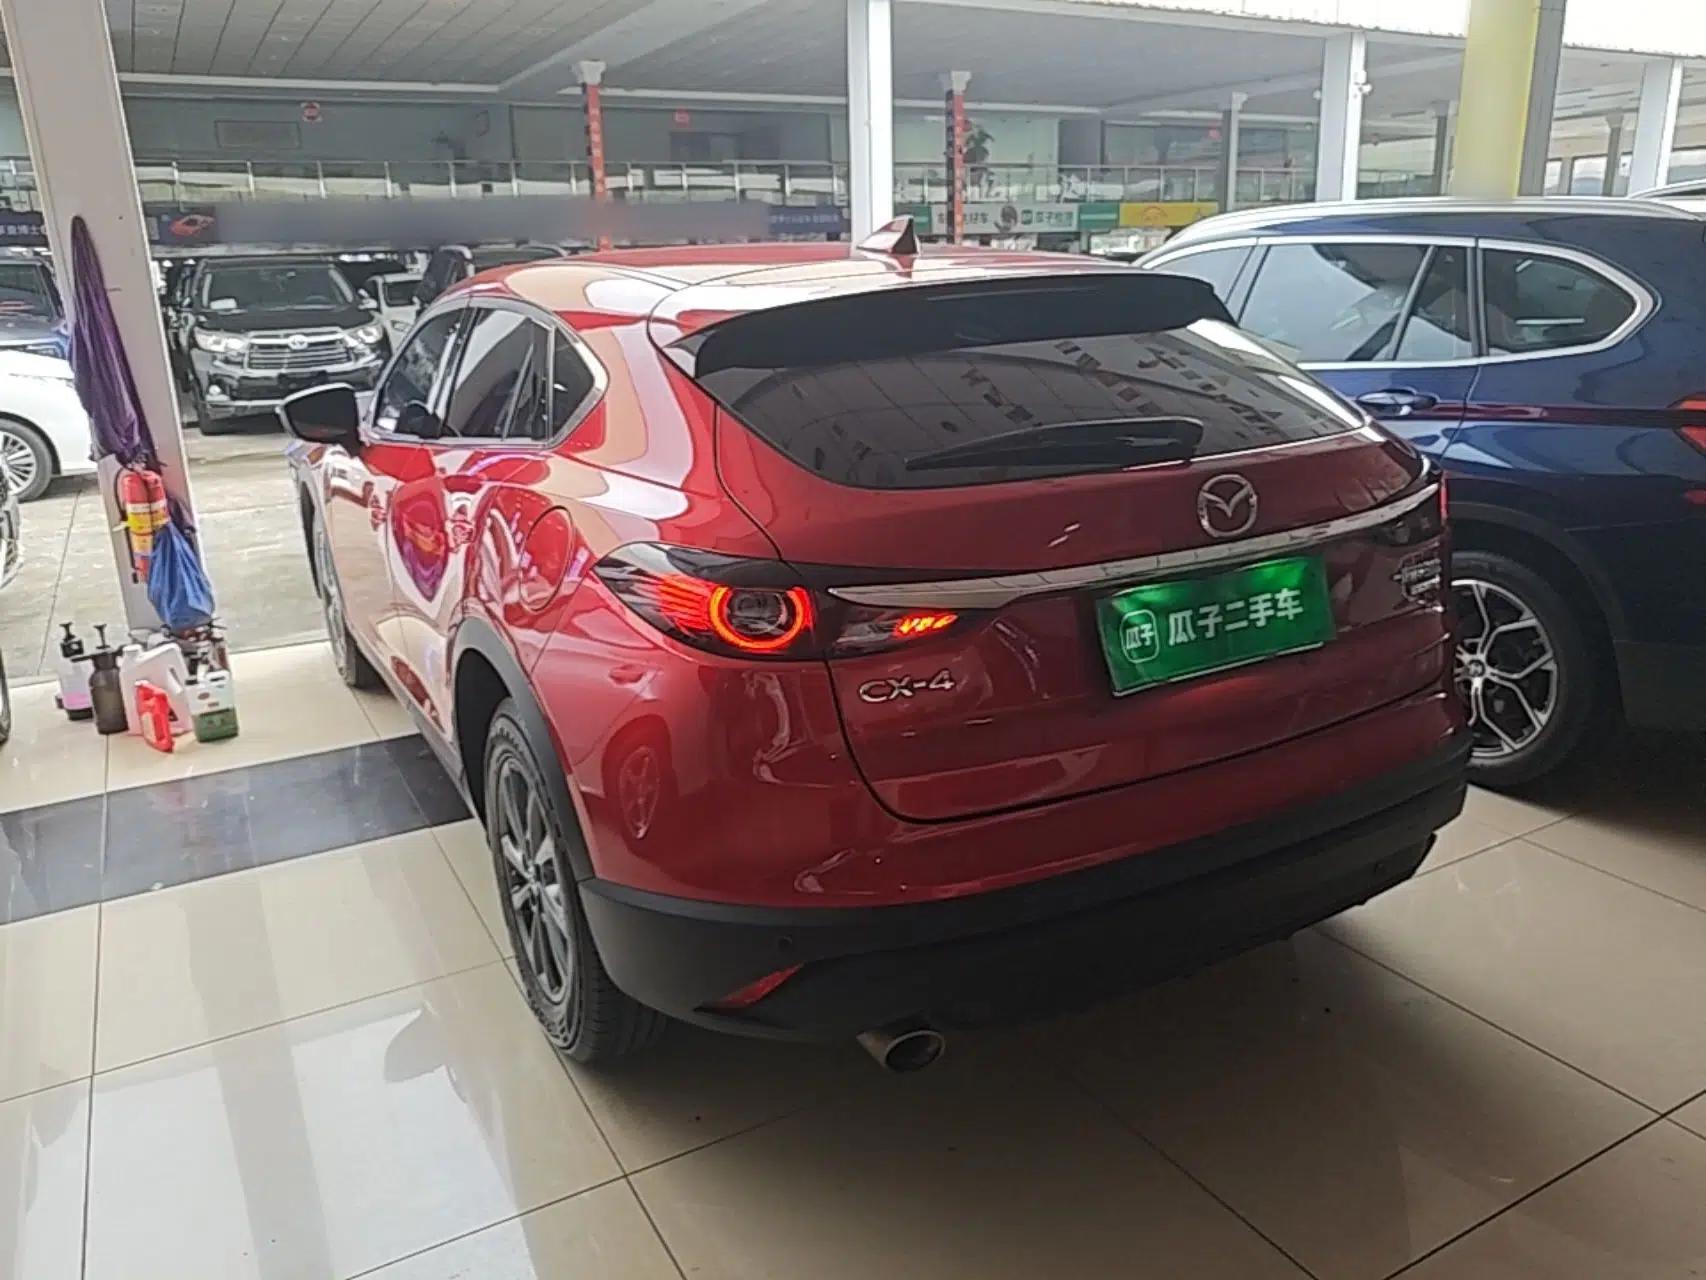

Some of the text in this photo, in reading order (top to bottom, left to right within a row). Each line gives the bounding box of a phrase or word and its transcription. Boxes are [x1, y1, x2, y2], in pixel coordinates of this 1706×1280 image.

[1168, 588, 1304, 646] 瓜子二手车
[1125, 623, 1154, 650] 瓜子
[859, 669, 955, 702] CX-4
